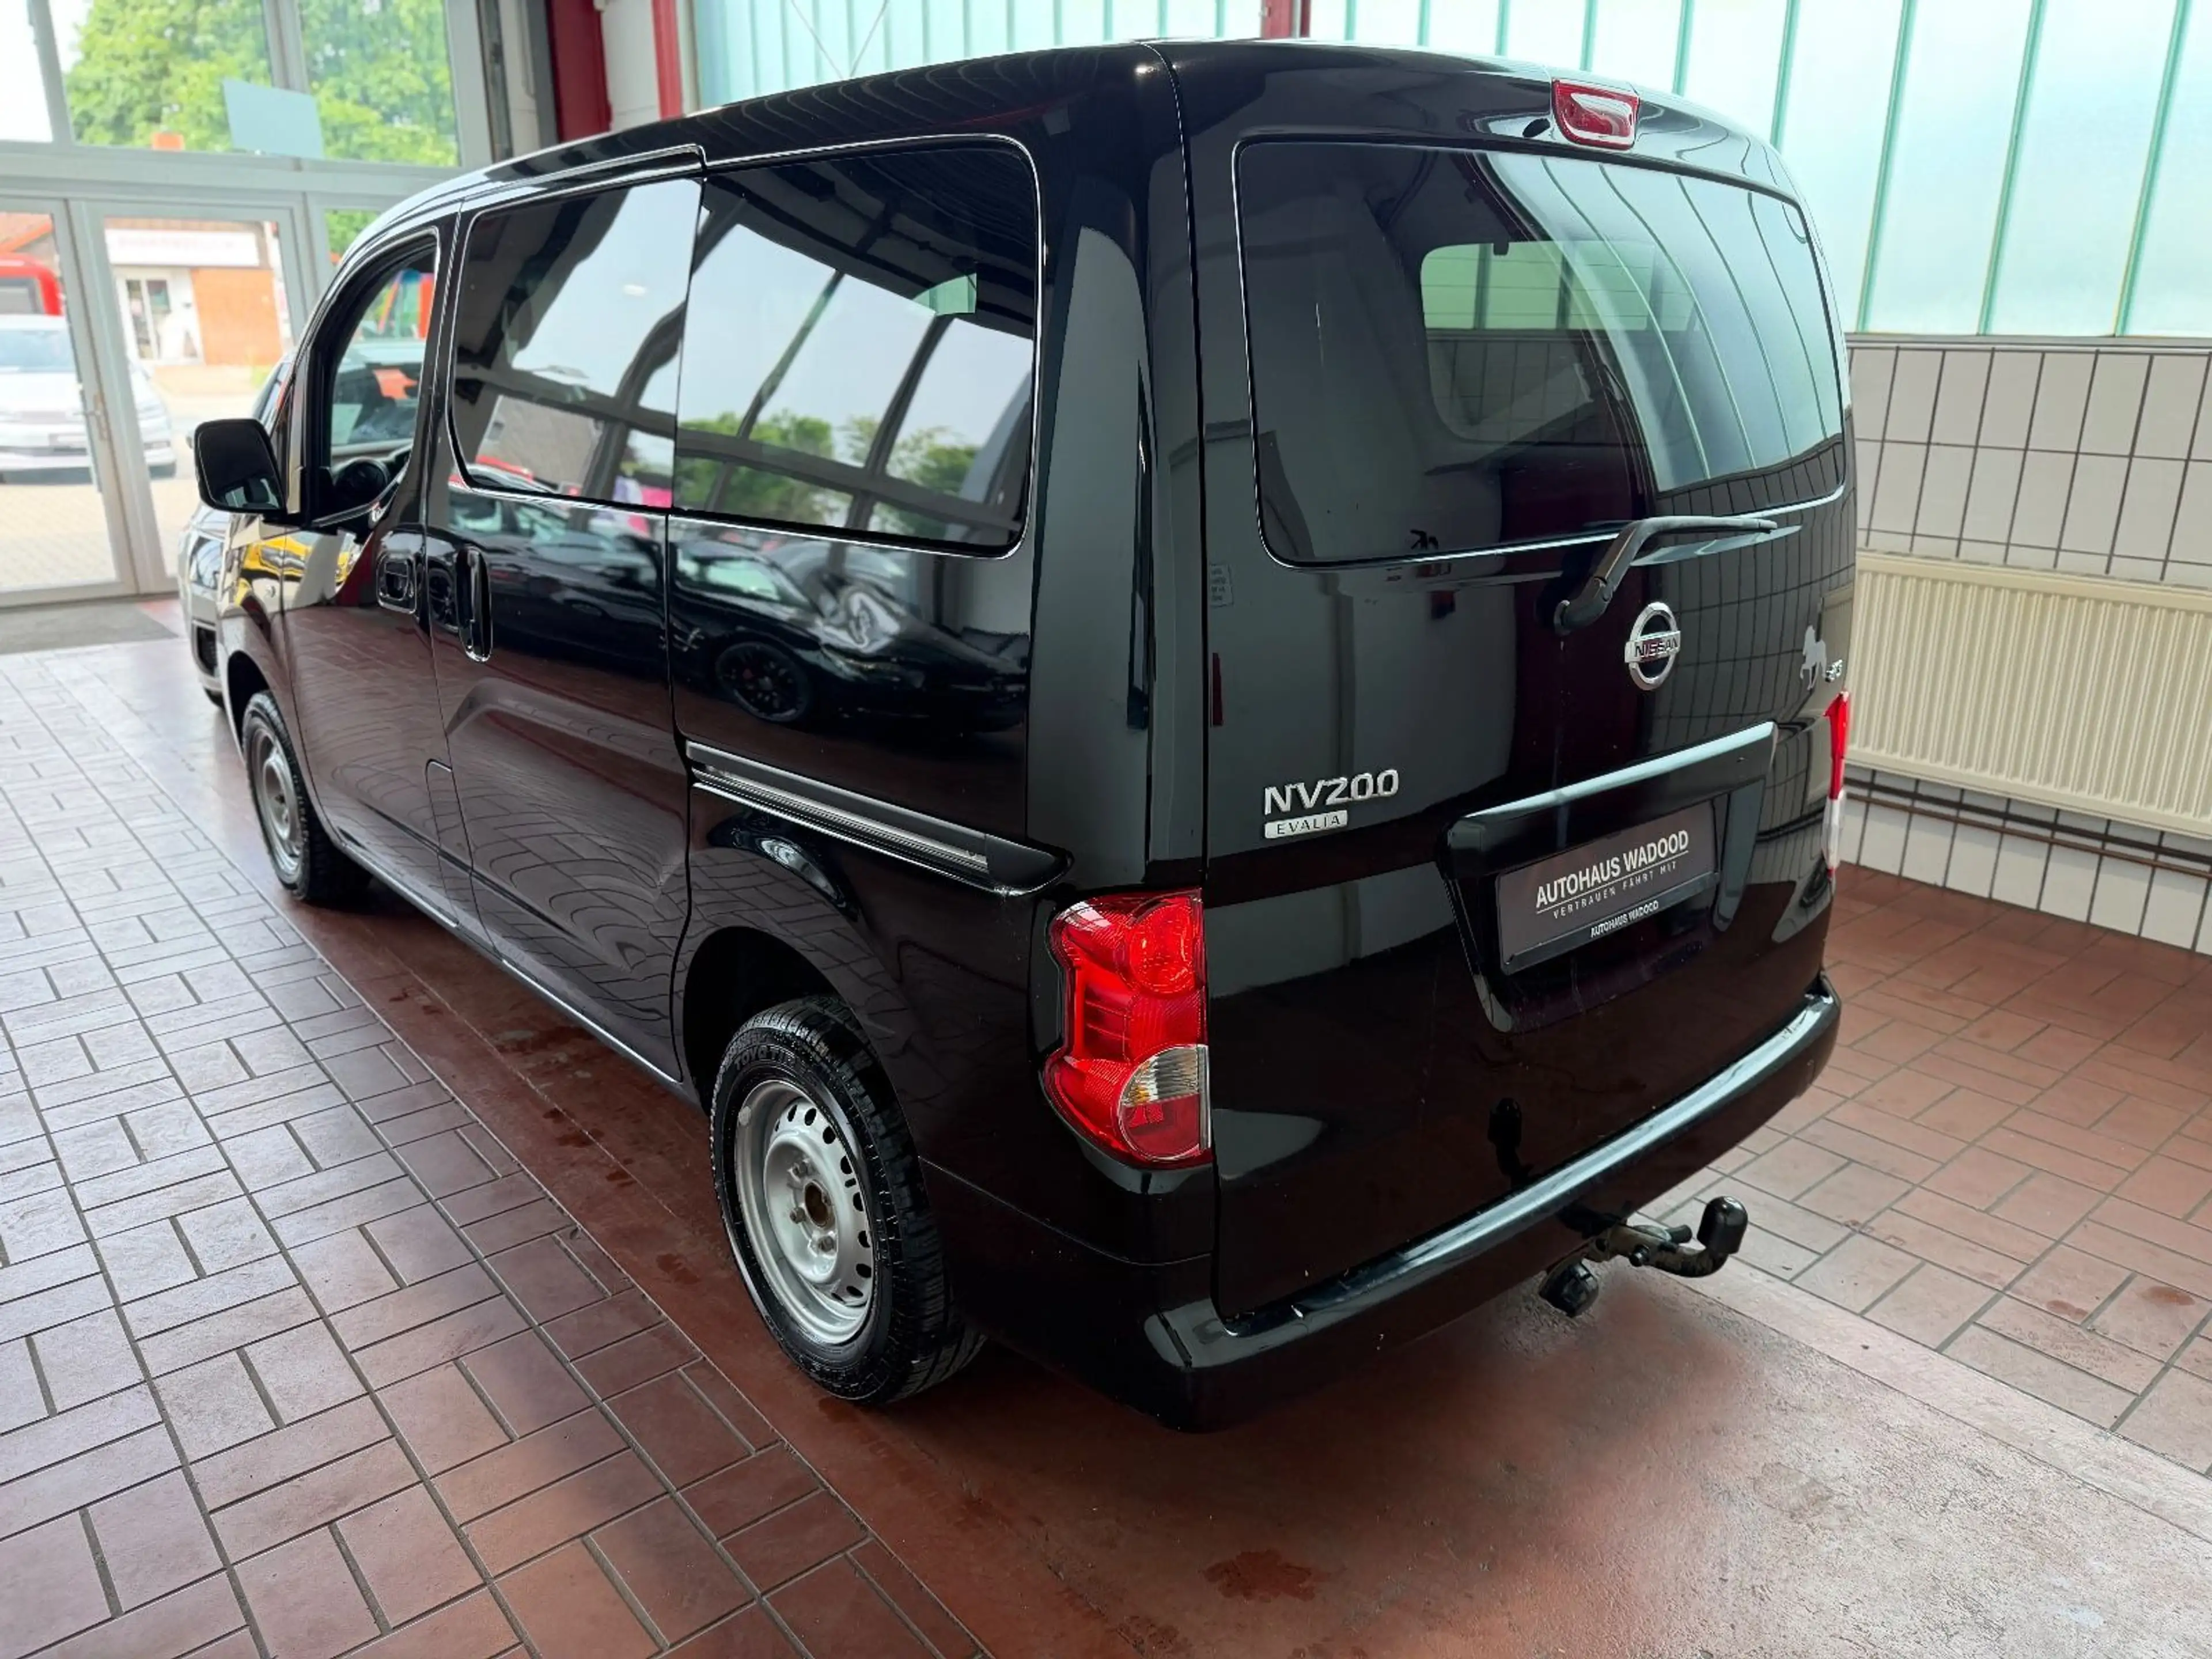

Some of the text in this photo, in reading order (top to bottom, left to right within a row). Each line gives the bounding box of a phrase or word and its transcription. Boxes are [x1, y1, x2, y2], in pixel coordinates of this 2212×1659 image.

[1635, 637, 1678, 658] NISSAN
[1264, 768, 1399, 815] NV200
[1277, 815, 1340, 835] EVALIA
[1536, 830, 1689, 908] AUTOHAUS WADOOD
[1553, 886, 1616, 919] VERTRAUEN
[1660, 861, 1677, 875] MIT
[1591, 900, 1660, 938] AUTOHAUS WADOOD
